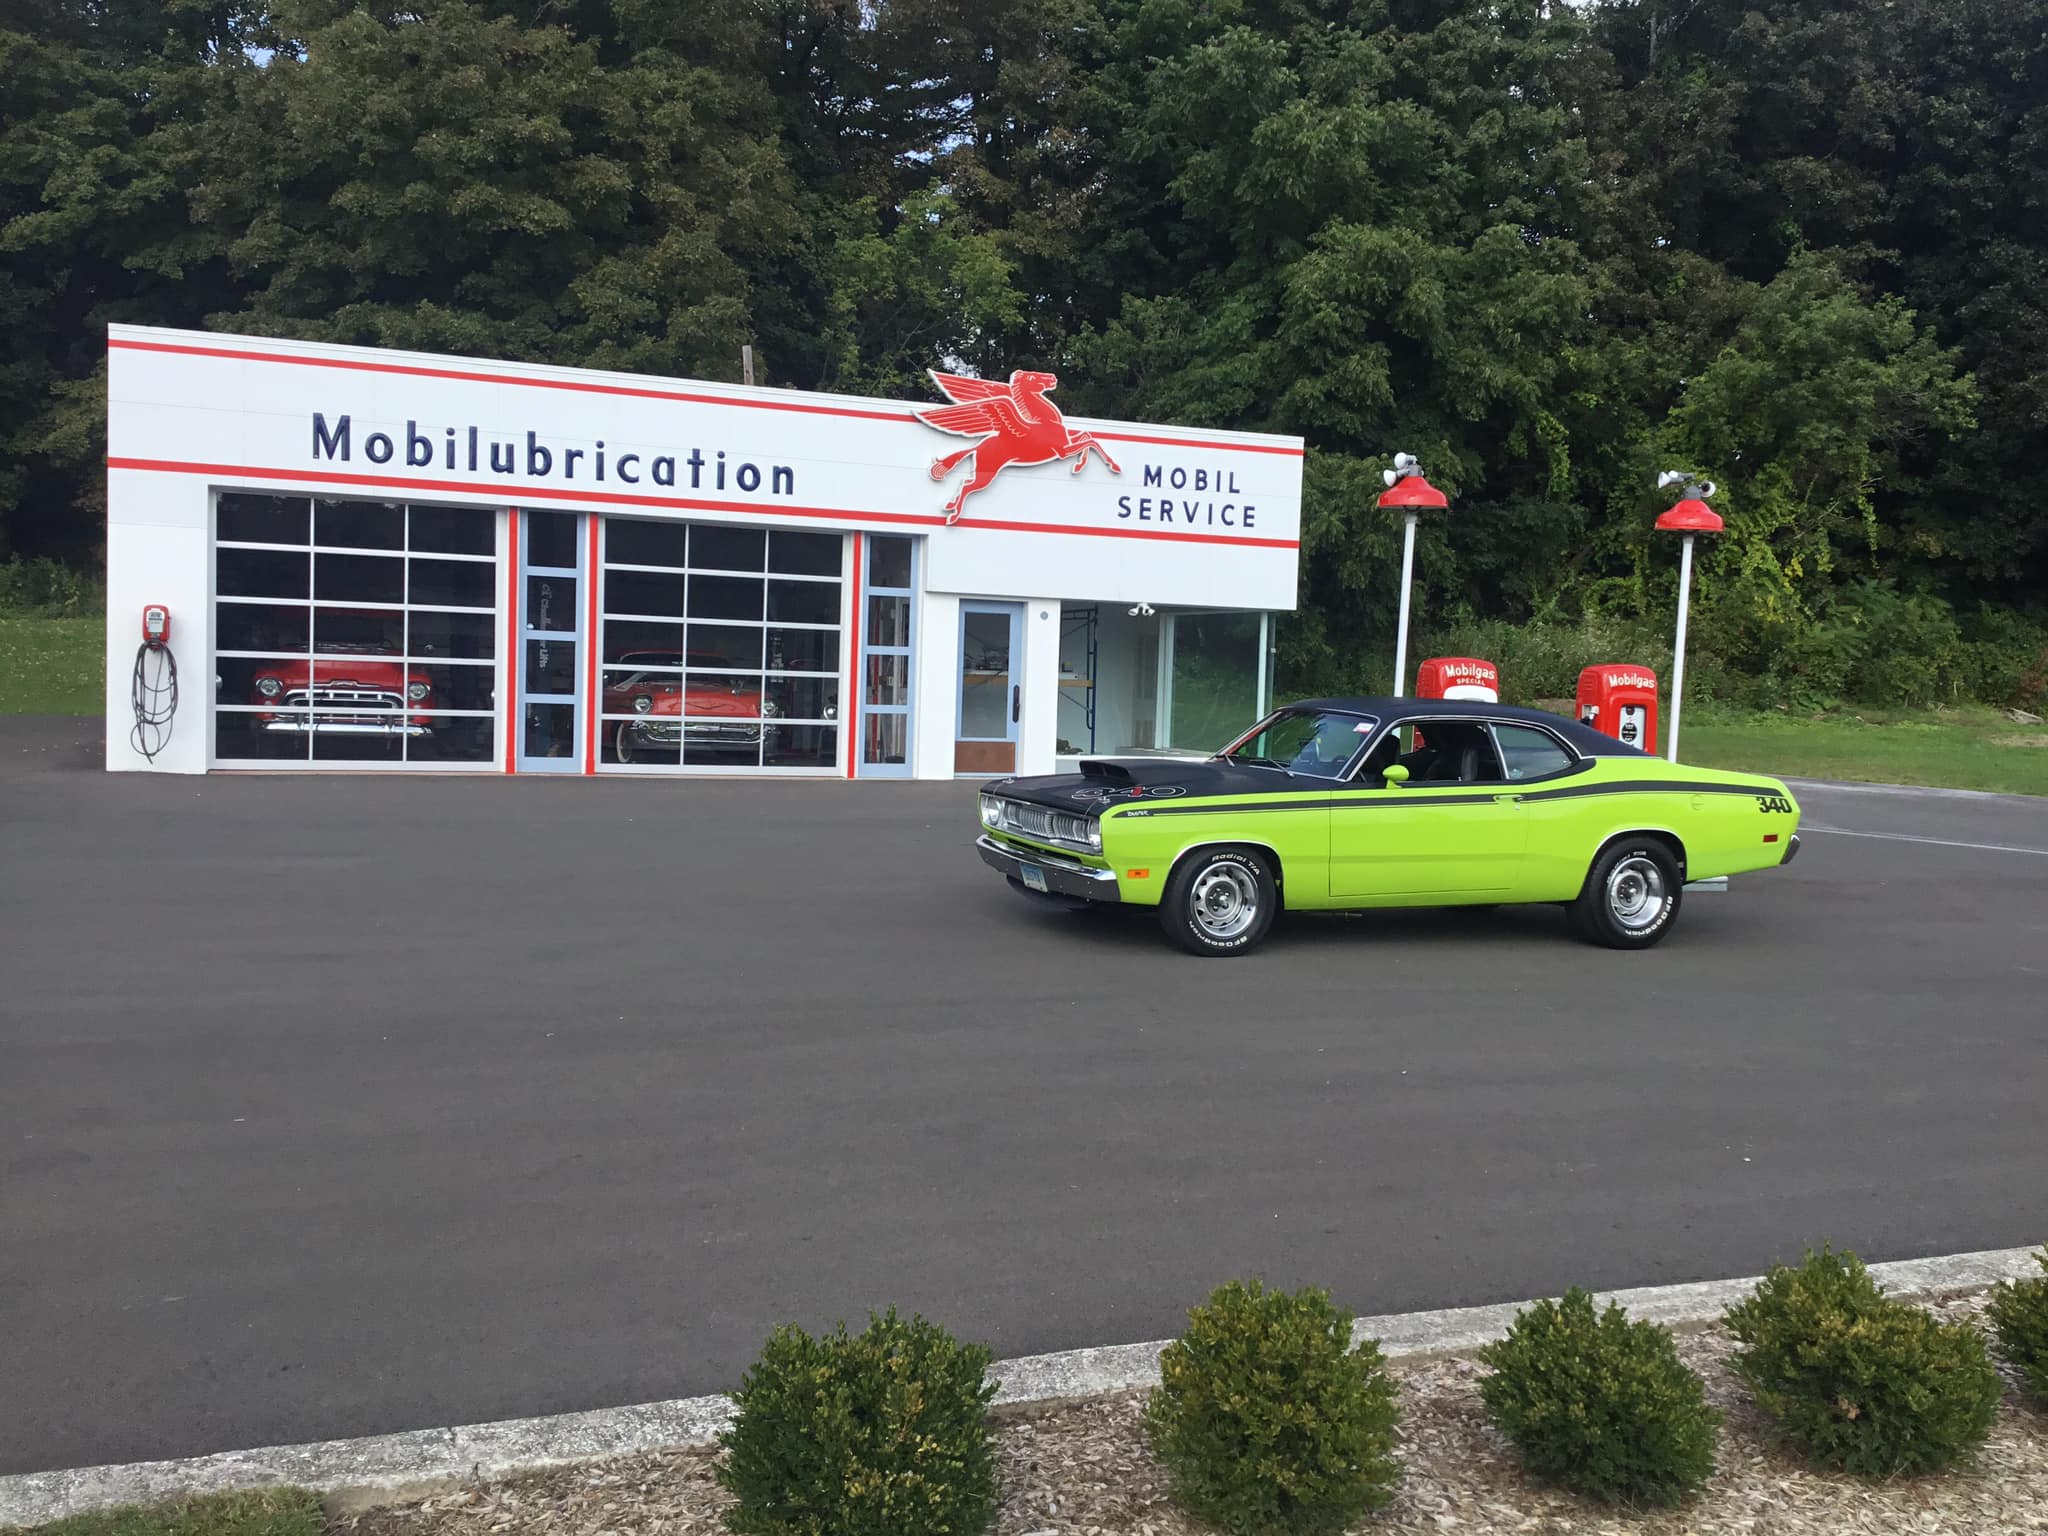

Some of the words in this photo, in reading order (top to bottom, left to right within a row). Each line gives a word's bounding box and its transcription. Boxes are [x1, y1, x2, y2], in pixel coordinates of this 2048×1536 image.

[312, 412, 795, 497] Mobilubrication
[1143, 463, 1242, 495] MOBIL
[1117, 496, 1257, 528] SERVICE
[1445, 663, 1496, 680] Mobilgas
[1608, 673, 1656, 689] Mobilgas
[1456, 678, 1486, 686] SPECIAL
[1756, 796, 1793, 813] 340
[1211, 853, 1247, 862] Radial
[1247, 860, 1261, 876] T/A
